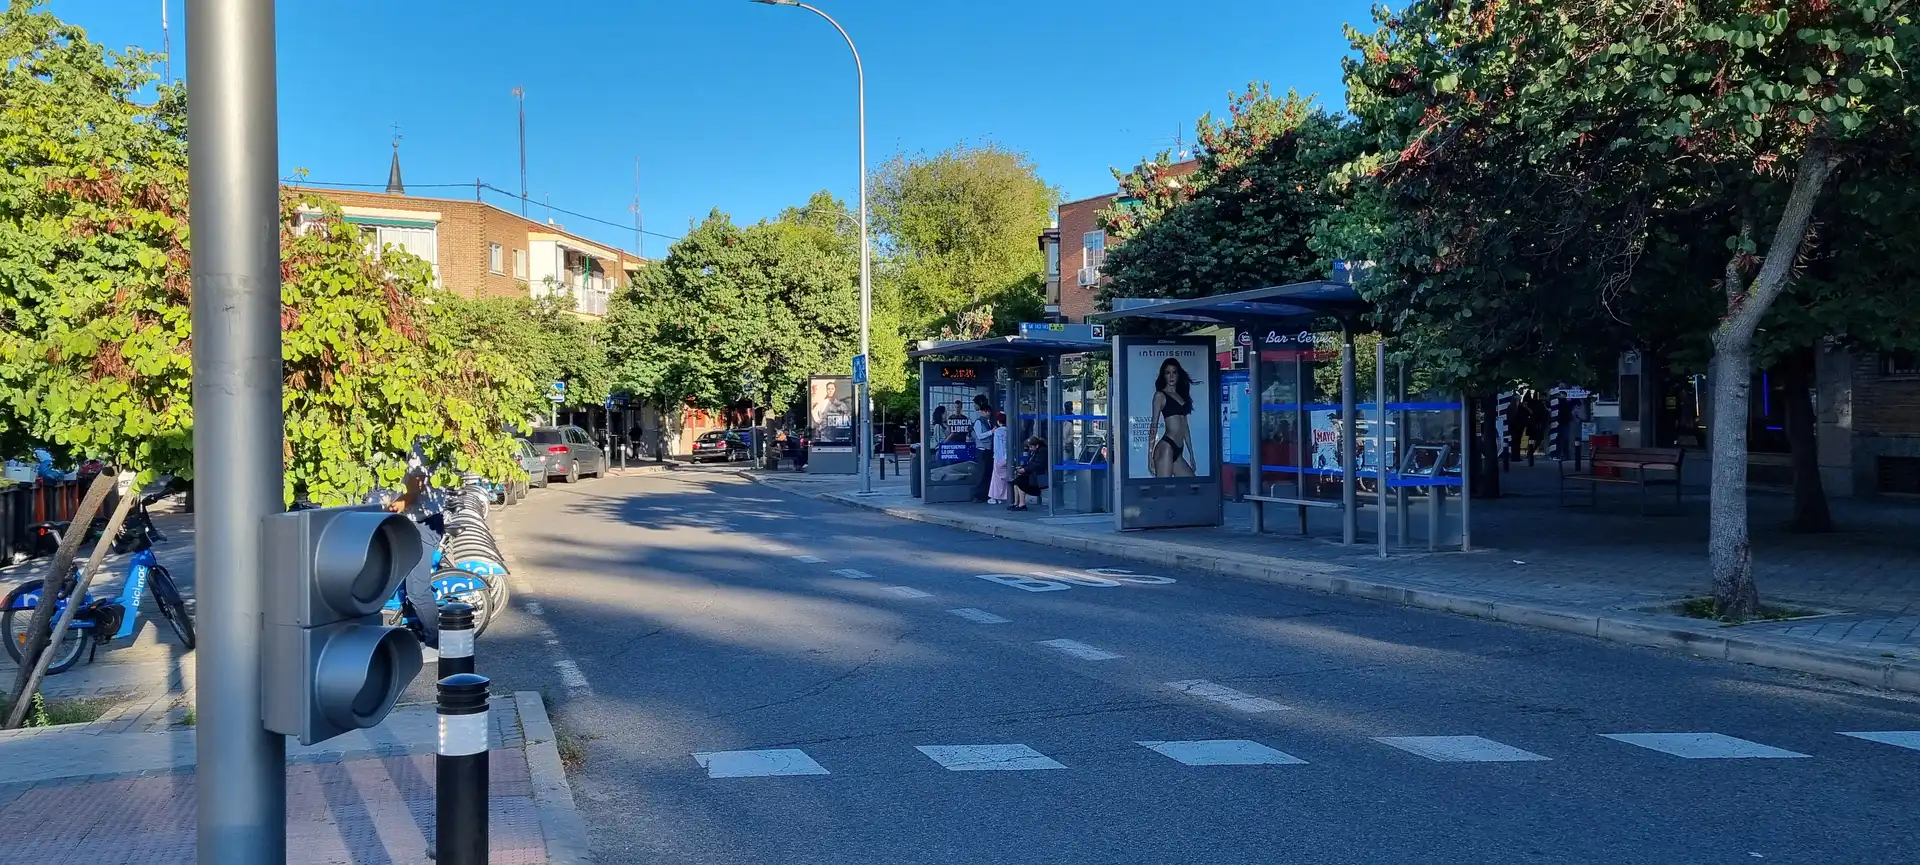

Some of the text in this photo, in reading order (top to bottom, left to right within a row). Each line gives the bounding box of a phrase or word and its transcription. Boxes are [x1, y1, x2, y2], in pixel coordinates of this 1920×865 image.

[1265, 330, 1289, 344] Bar
[1139, 349, 1195, 357] intimissimi
[827, 415, 852, 427] BERLIN
[950, 425, 969, 433] LIBRE
[1316, 431, 1336, 443] MAYO
[975, 568, 1177, 592] BUS
